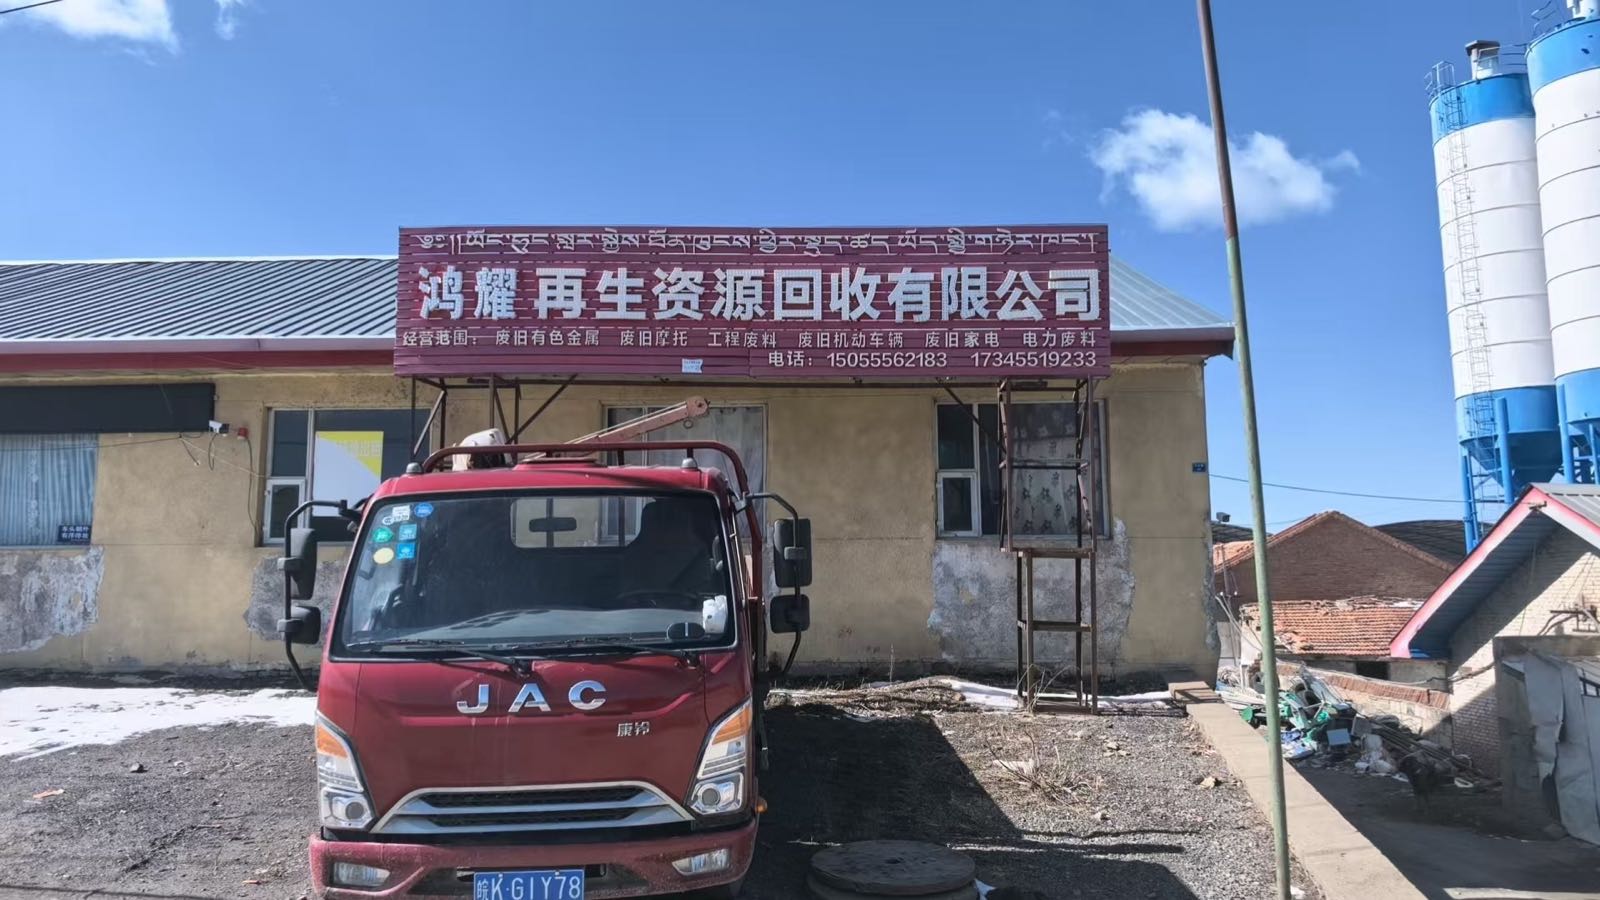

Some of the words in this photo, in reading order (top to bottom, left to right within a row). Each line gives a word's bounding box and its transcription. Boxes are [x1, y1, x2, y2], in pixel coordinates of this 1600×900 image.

[418, 265, 1099, 322] 鸿耀再生资源回收有限公司
[495, 329, 599, 346] 废旧有色金属
[620, 329, 688, 346] 废旧摩托
[707, 330, 777, 347] 工程废料
[798, 331, 904, 348] 废旧机动车辆
[925, 331, 999, 348] 废旧家电
[1022, 331, 1096, 347] 电力废料
[826, 352, 947, 368] 15055562183
[970, 352, 1096, 368] 17345519233
[456, 679, 607, 714] JAC
[617, 721, 650, 737] 康铃
